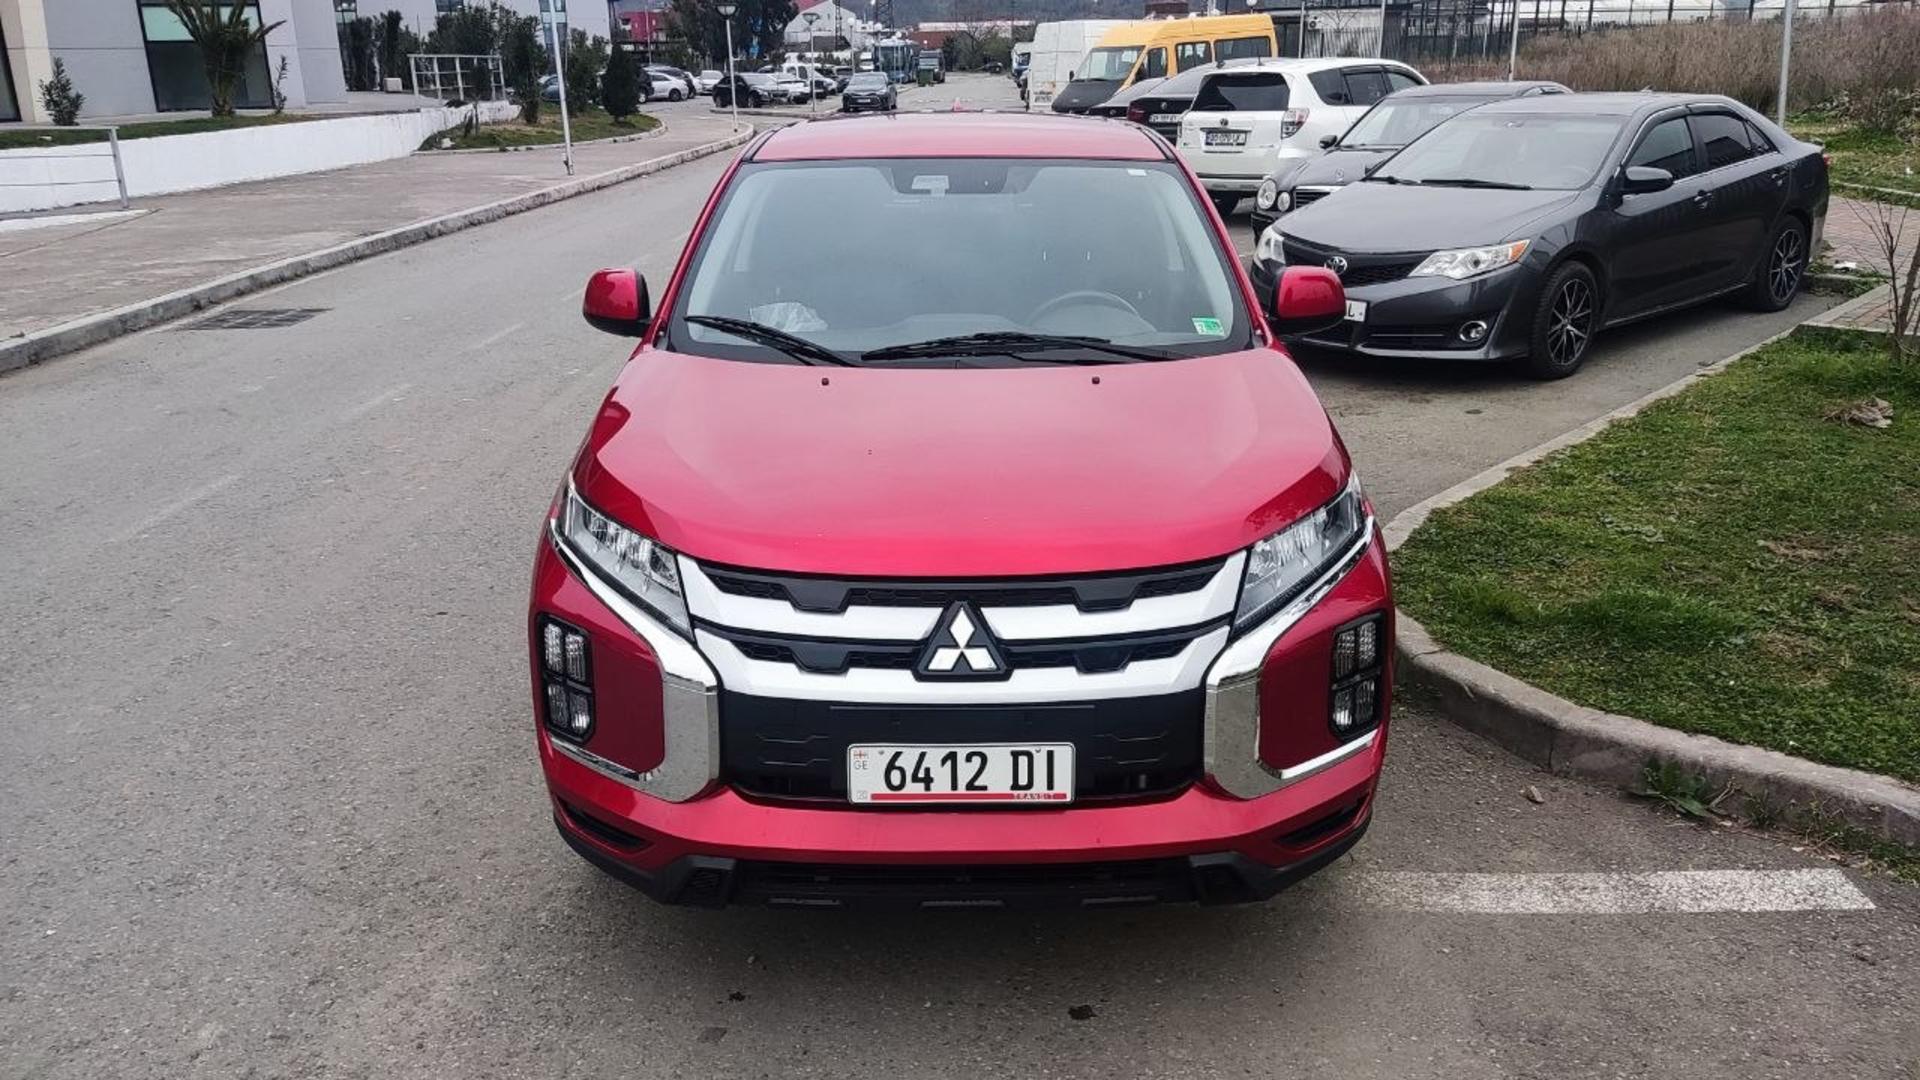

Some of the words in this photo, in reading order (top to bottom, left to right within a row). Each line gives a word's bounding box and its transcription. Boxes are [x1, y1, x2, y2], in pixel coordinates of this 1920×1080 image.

[854, 760, 868, 770] GE
[884, 751, 988, 791] 6412
[1010, 750, 1054, 791] DI
